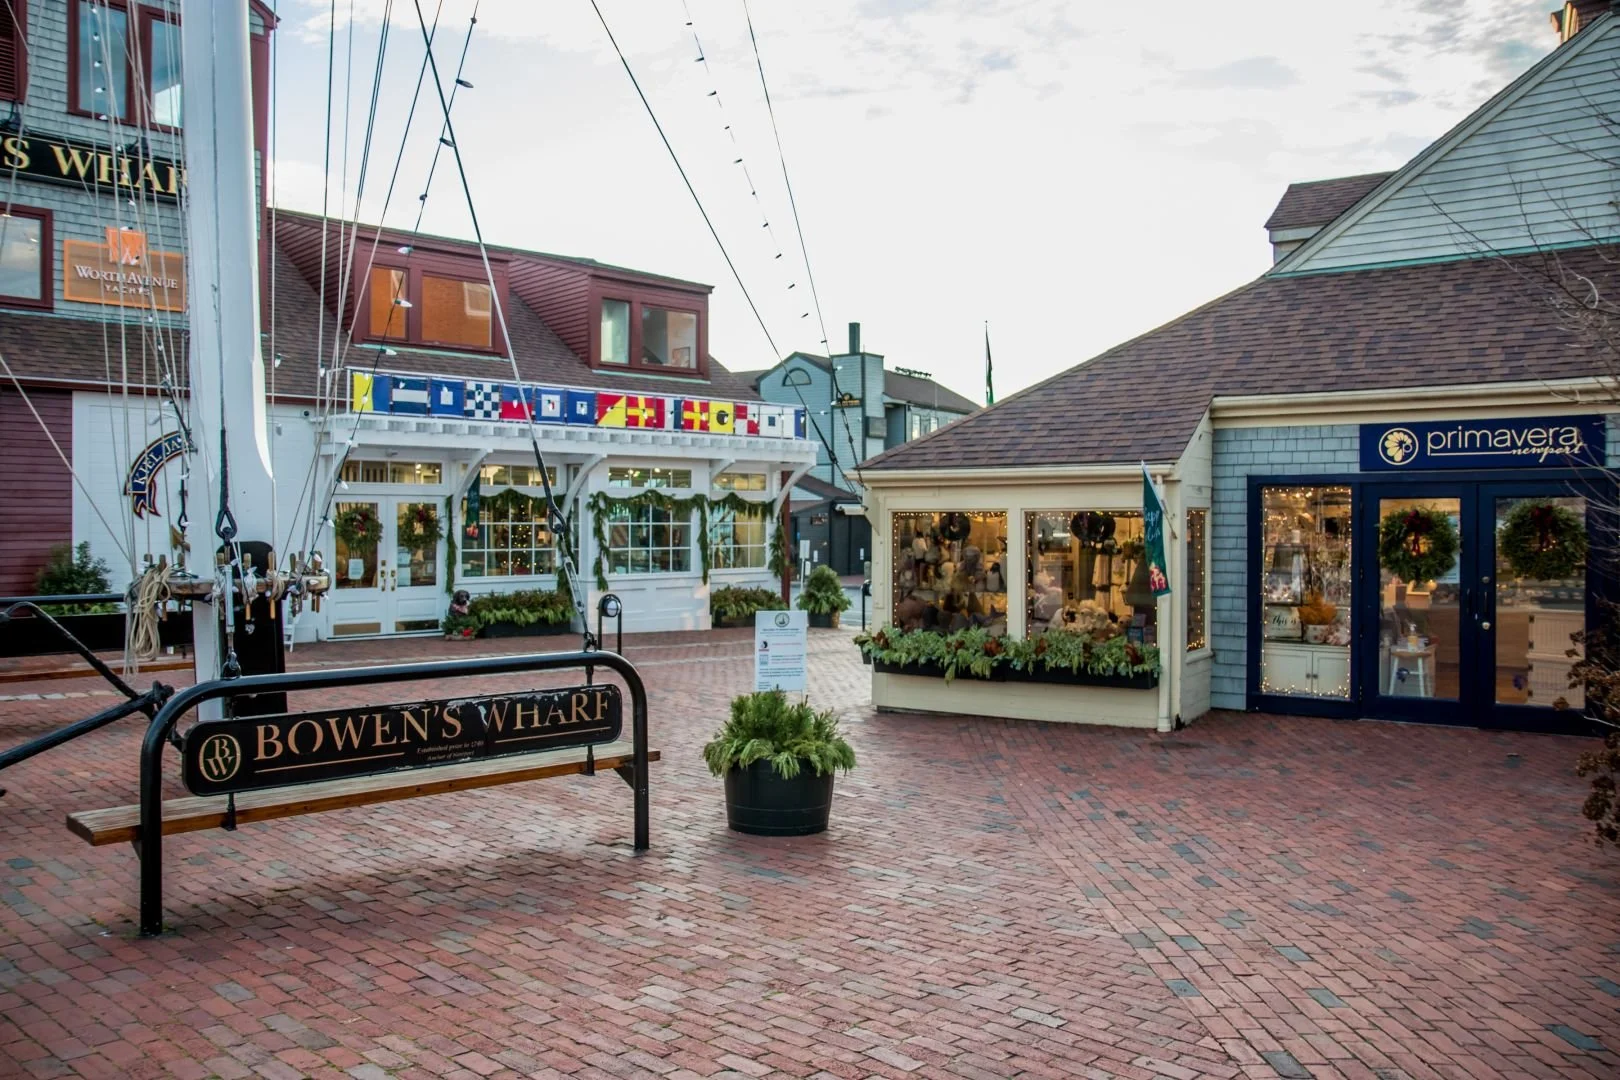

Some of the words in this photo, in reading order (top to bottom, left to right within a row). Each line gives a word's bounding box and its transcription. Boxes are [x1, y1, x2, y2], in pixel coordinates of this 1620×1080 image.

[74, 264, 126, 281] WORTH
[127, 271, 178, 289] AVENUE
[1427, 426, 1578, 456] primavera
[1511, 443, 1582, 463] newport
[133, 452, 162, 485] KIEL
[164, 437, 188, 455] JA
[253, 705, 463, 760] BOWEN'S
[478, 690, 612, 733] WHARF
